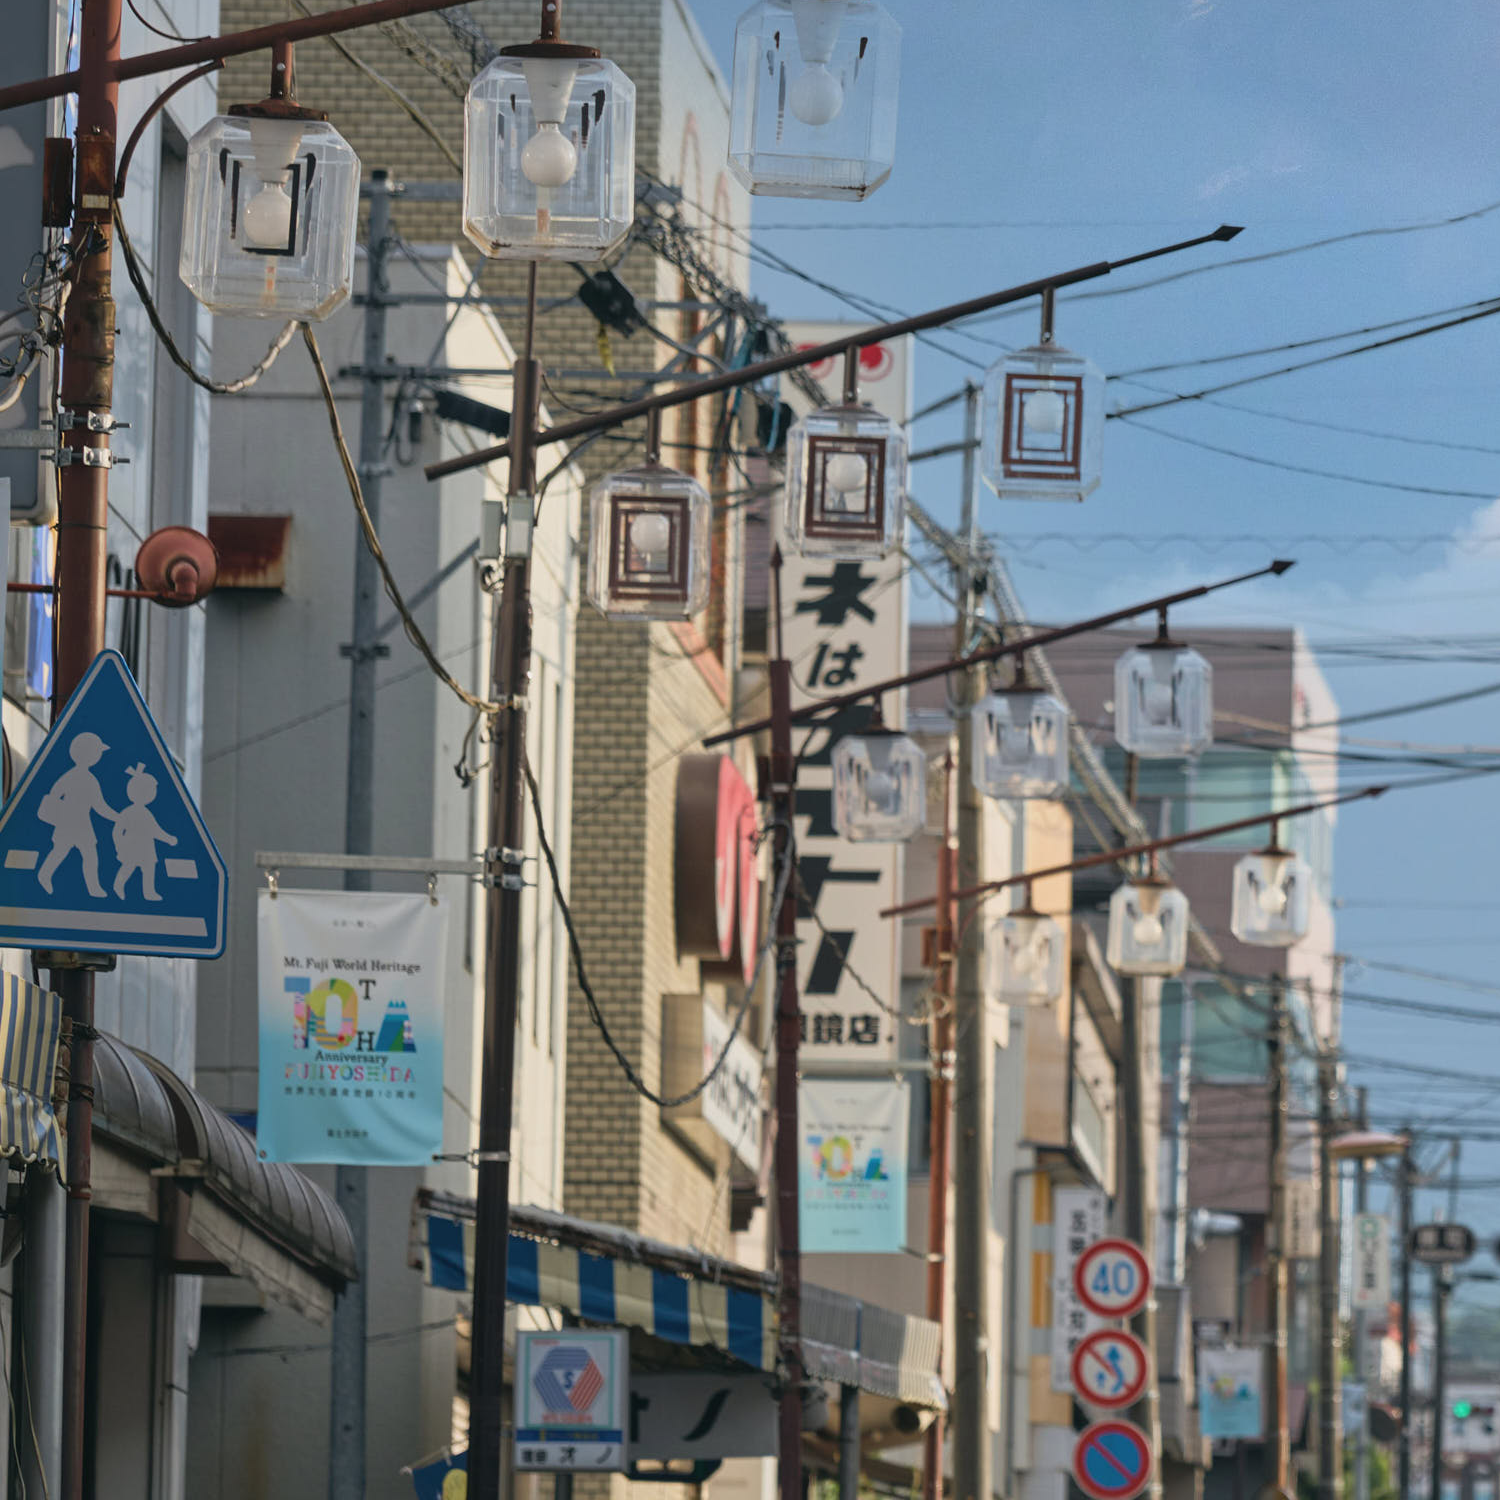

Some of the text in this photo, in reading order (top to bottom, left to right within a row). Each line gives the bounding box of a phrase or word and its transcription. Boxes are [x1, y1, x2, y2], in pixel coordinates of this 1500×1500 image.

[284, 956, 421, 975] Mt. Fuji World Heritage
[798, 1013, 881, 1046] 鏡店
[315, 1051, 388, 1065] Anniversary
[285, 1064, 416, 1083] FUJIYOSHIDA
[1092, 1262, 1135, 1296] 40
